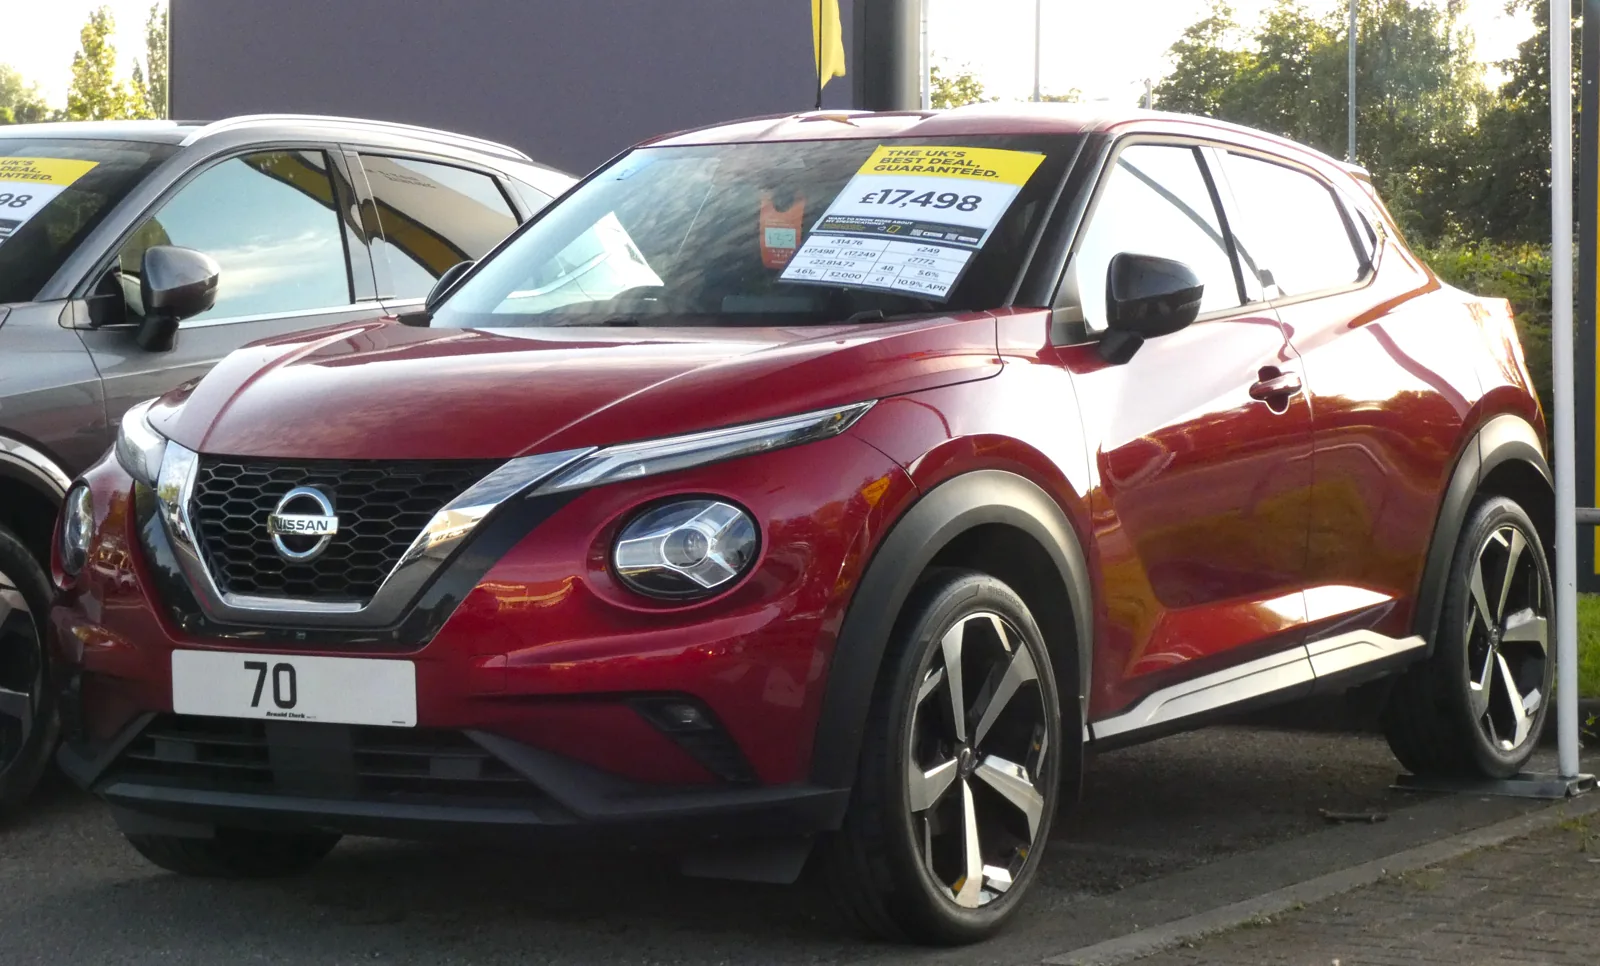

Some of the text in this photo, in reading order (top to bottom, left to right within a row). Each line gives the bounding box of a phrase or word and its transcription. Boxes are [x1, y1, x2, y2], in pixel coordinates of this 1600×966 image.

[926, 150, 967, 158] UK'S
[879, 157, 981, 168] BEST DEAL,
[873, 165, 1000, 178] GUARANTEED.
[858, 188, 983, 212] £17,498
[925, 284, 947, 292] APR
[272, 517, 328, 531] NISSAN
[244, 661, 297, 709] 70
